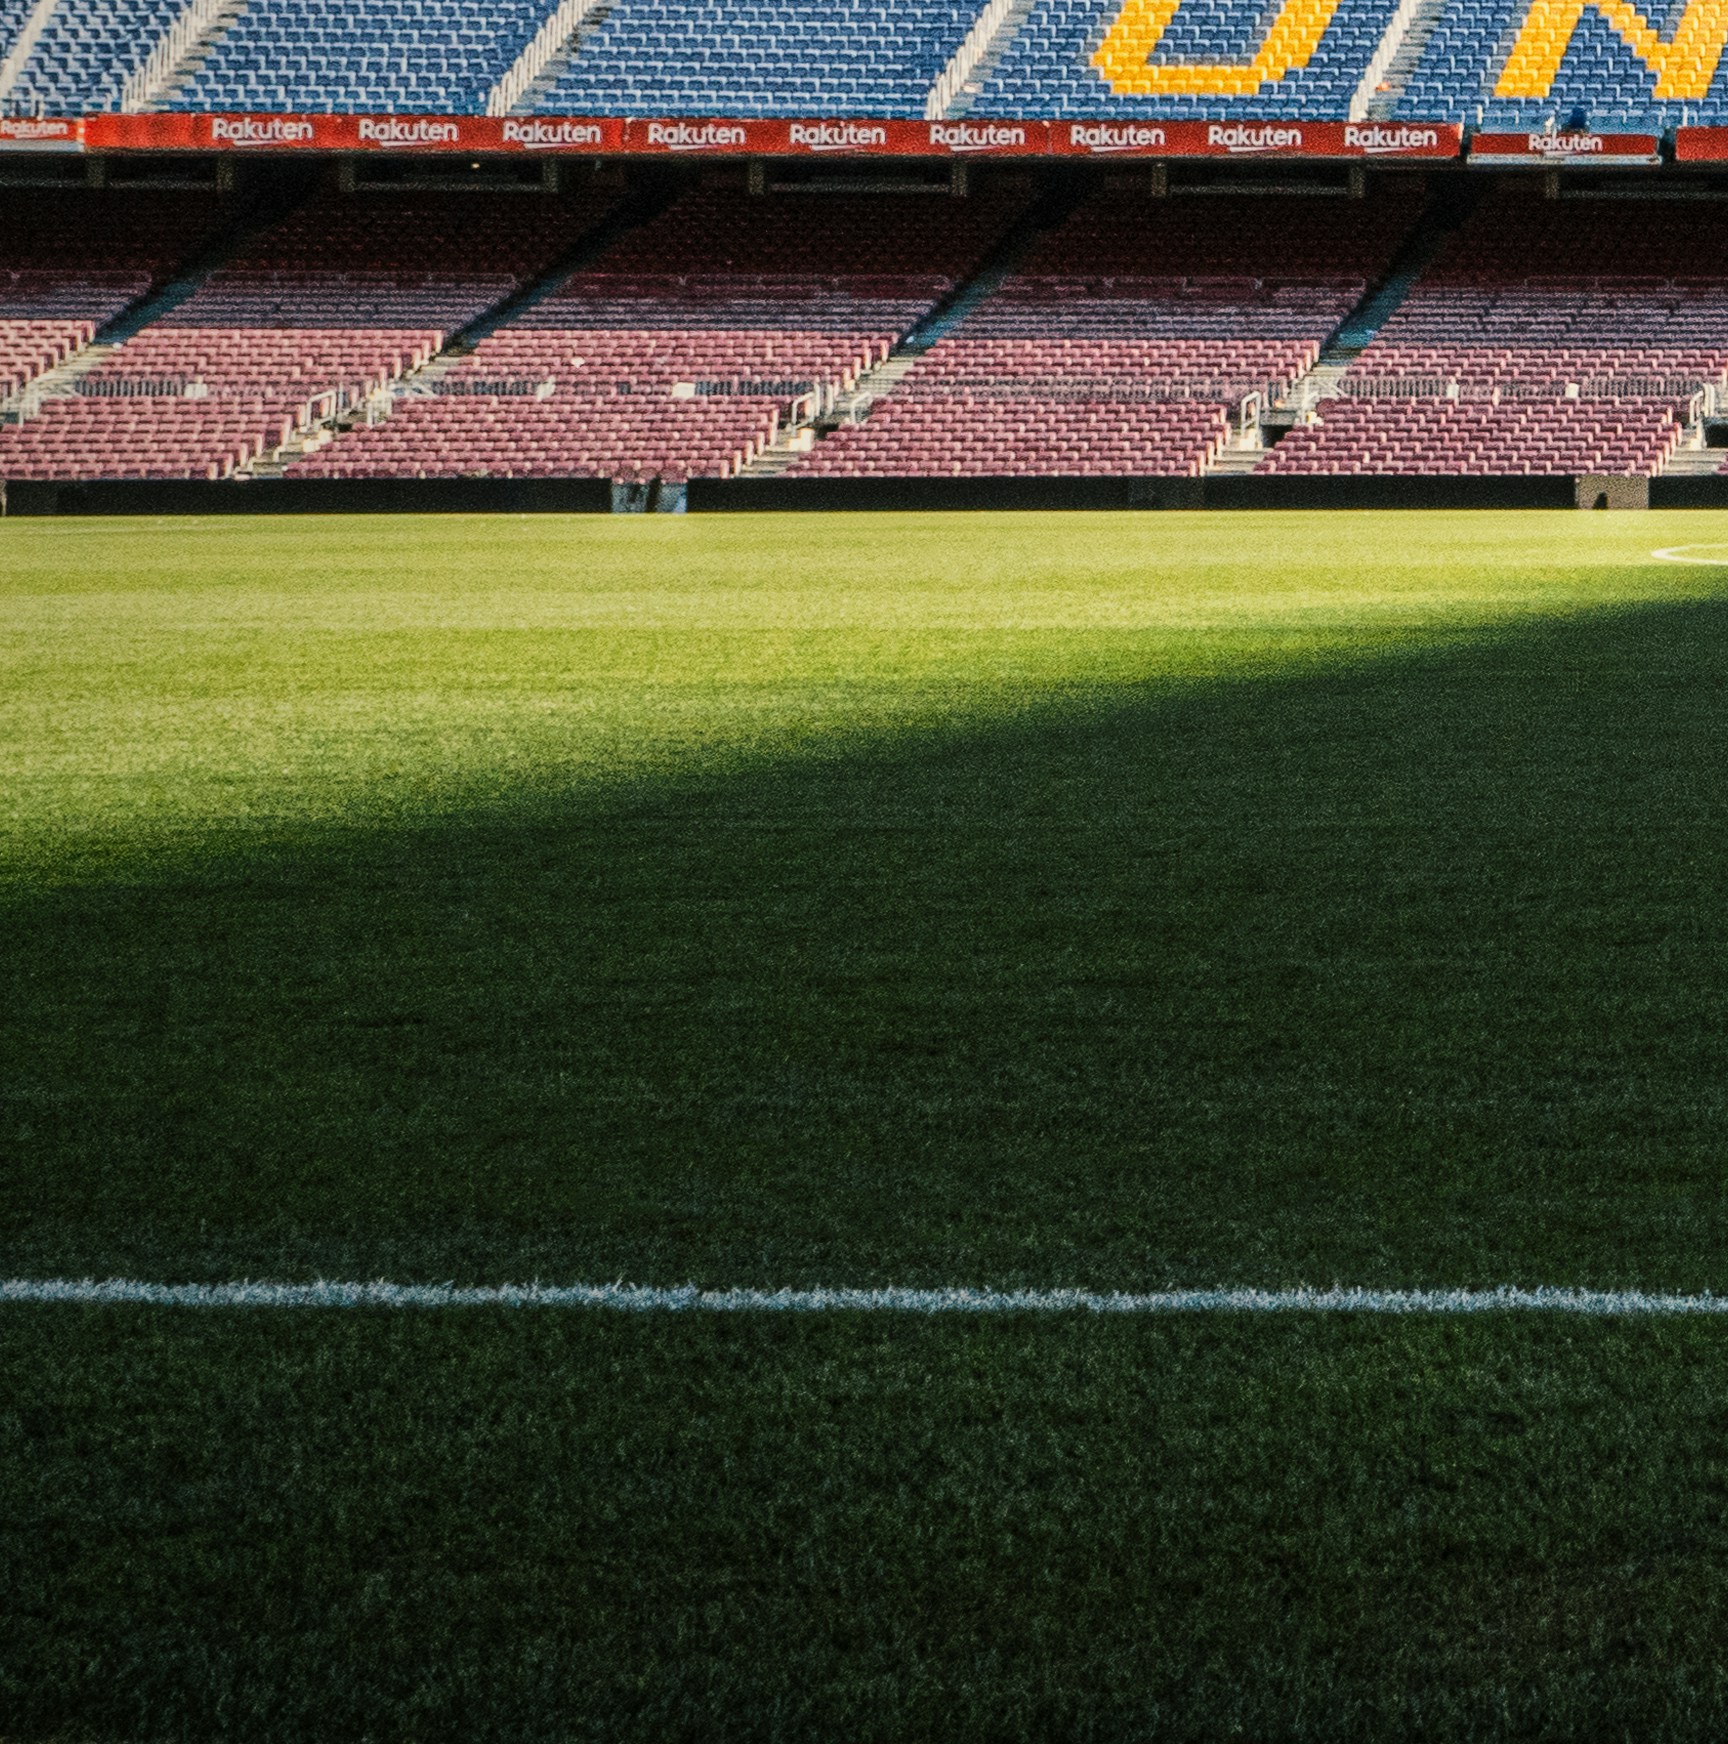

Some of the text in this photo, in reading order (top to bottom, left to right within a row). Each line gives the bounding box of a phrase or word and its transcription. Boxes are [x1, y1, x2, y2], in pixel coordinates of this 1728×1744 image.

[0, 120, 68, 136] Rakuten
[212, 119, 313, 141] Rakuten
[360, 119, 458, 141] Rakuten
[503, 121, 601, 142] Rakuten
[648, 123, 745, 144] Rakuten
[790, 124, 885, 145] Rakuten
[930, 125, 1025, 146] Rakuten
[1071, 125, 1165, 145] Rakuten
[1209, 126, 1301, 146] Rakuten
[1345, 127, 1437, 147] Rakuten
[1529, 133, 1602, 152] Rakuten
